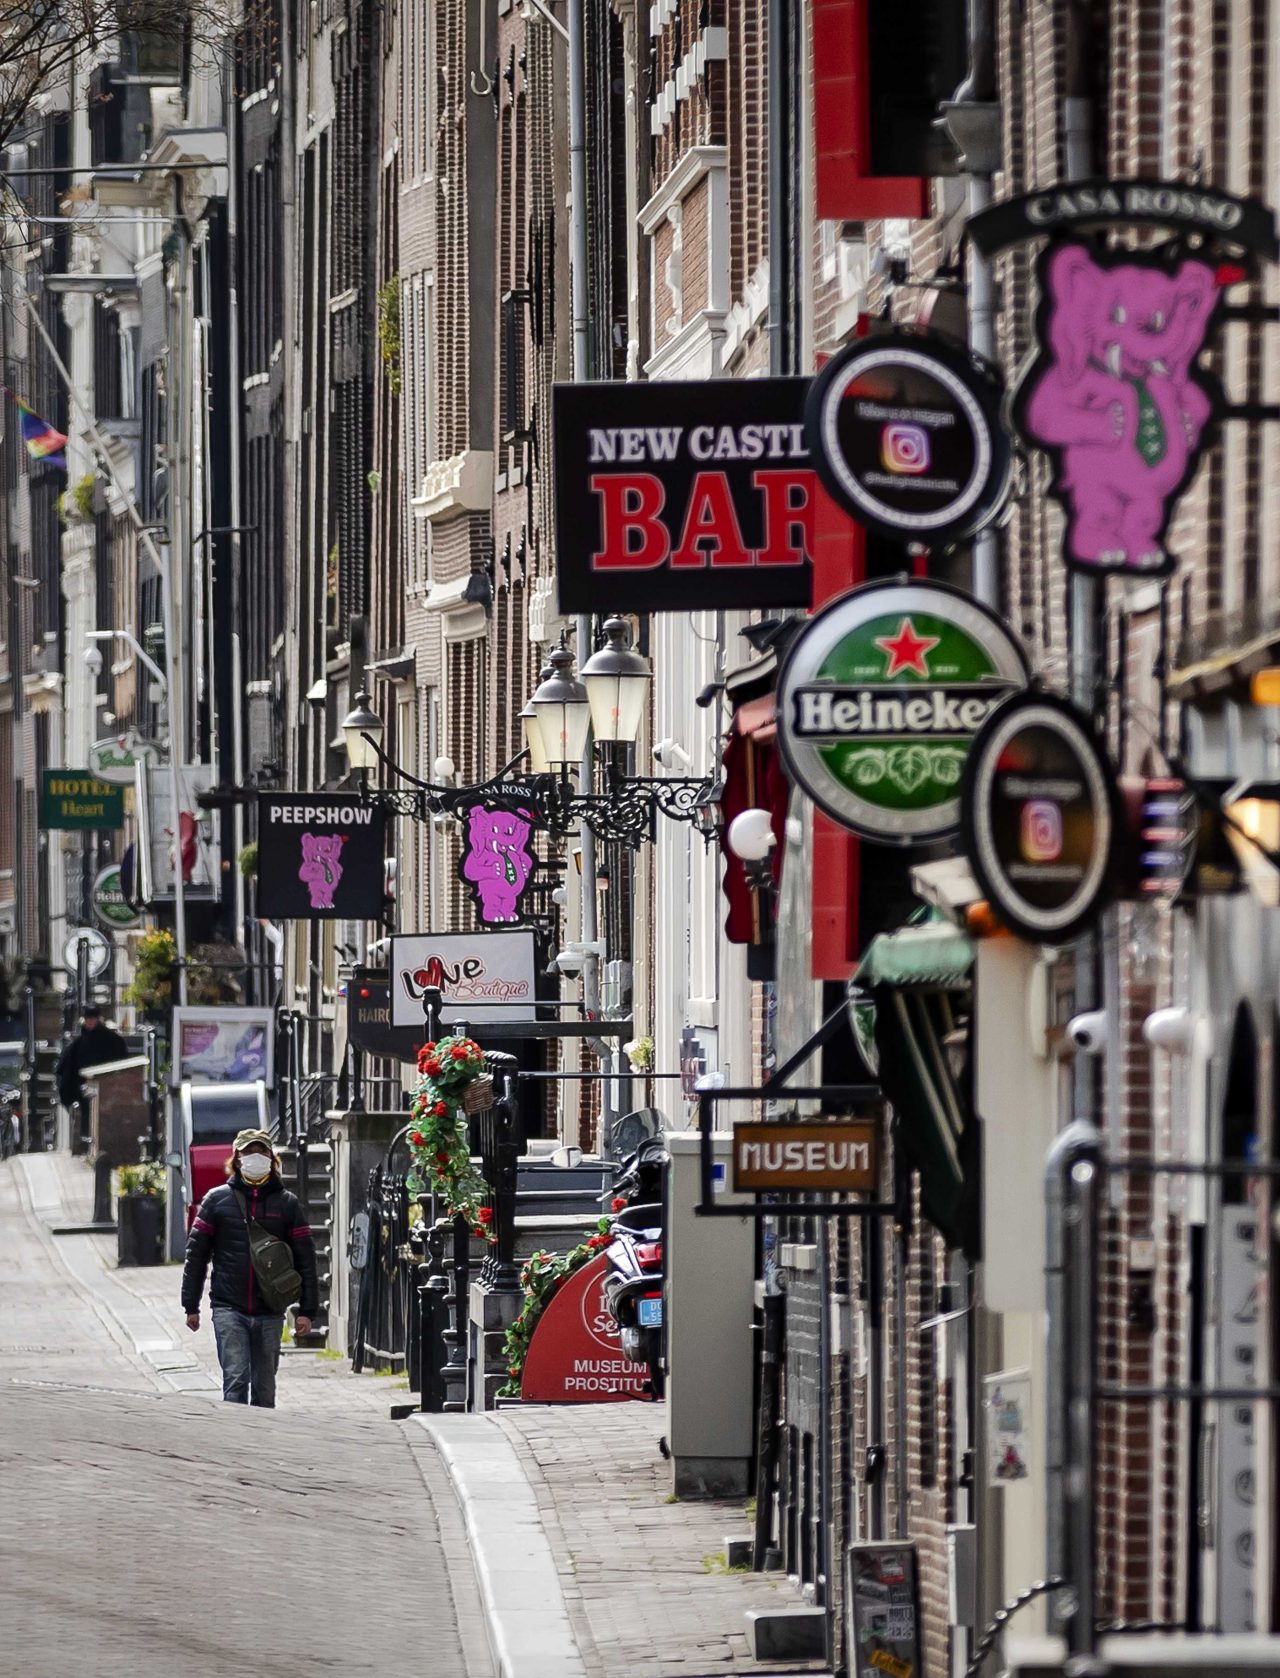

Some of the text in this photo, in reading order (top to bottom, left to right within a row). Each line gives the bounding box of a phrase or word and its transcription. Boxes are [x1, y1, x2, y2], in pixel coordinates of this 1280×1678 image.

[1025, 187, 1242, 230] CASA ROSSO
[588, 424, 810, 462] NEW CASTL
[591, 469, 816, 571] BAR
[49, 779, 117, 796] HOTEL
[270, 805, 373, 825] PEEPSHOW
[96, 890, 124, 902] Hein
[454, 979, 527, 1001] Boutique
[739, 1141, 869, 1171] MUSEUM
[574, 1360, 647, 1373] MUSEUM
